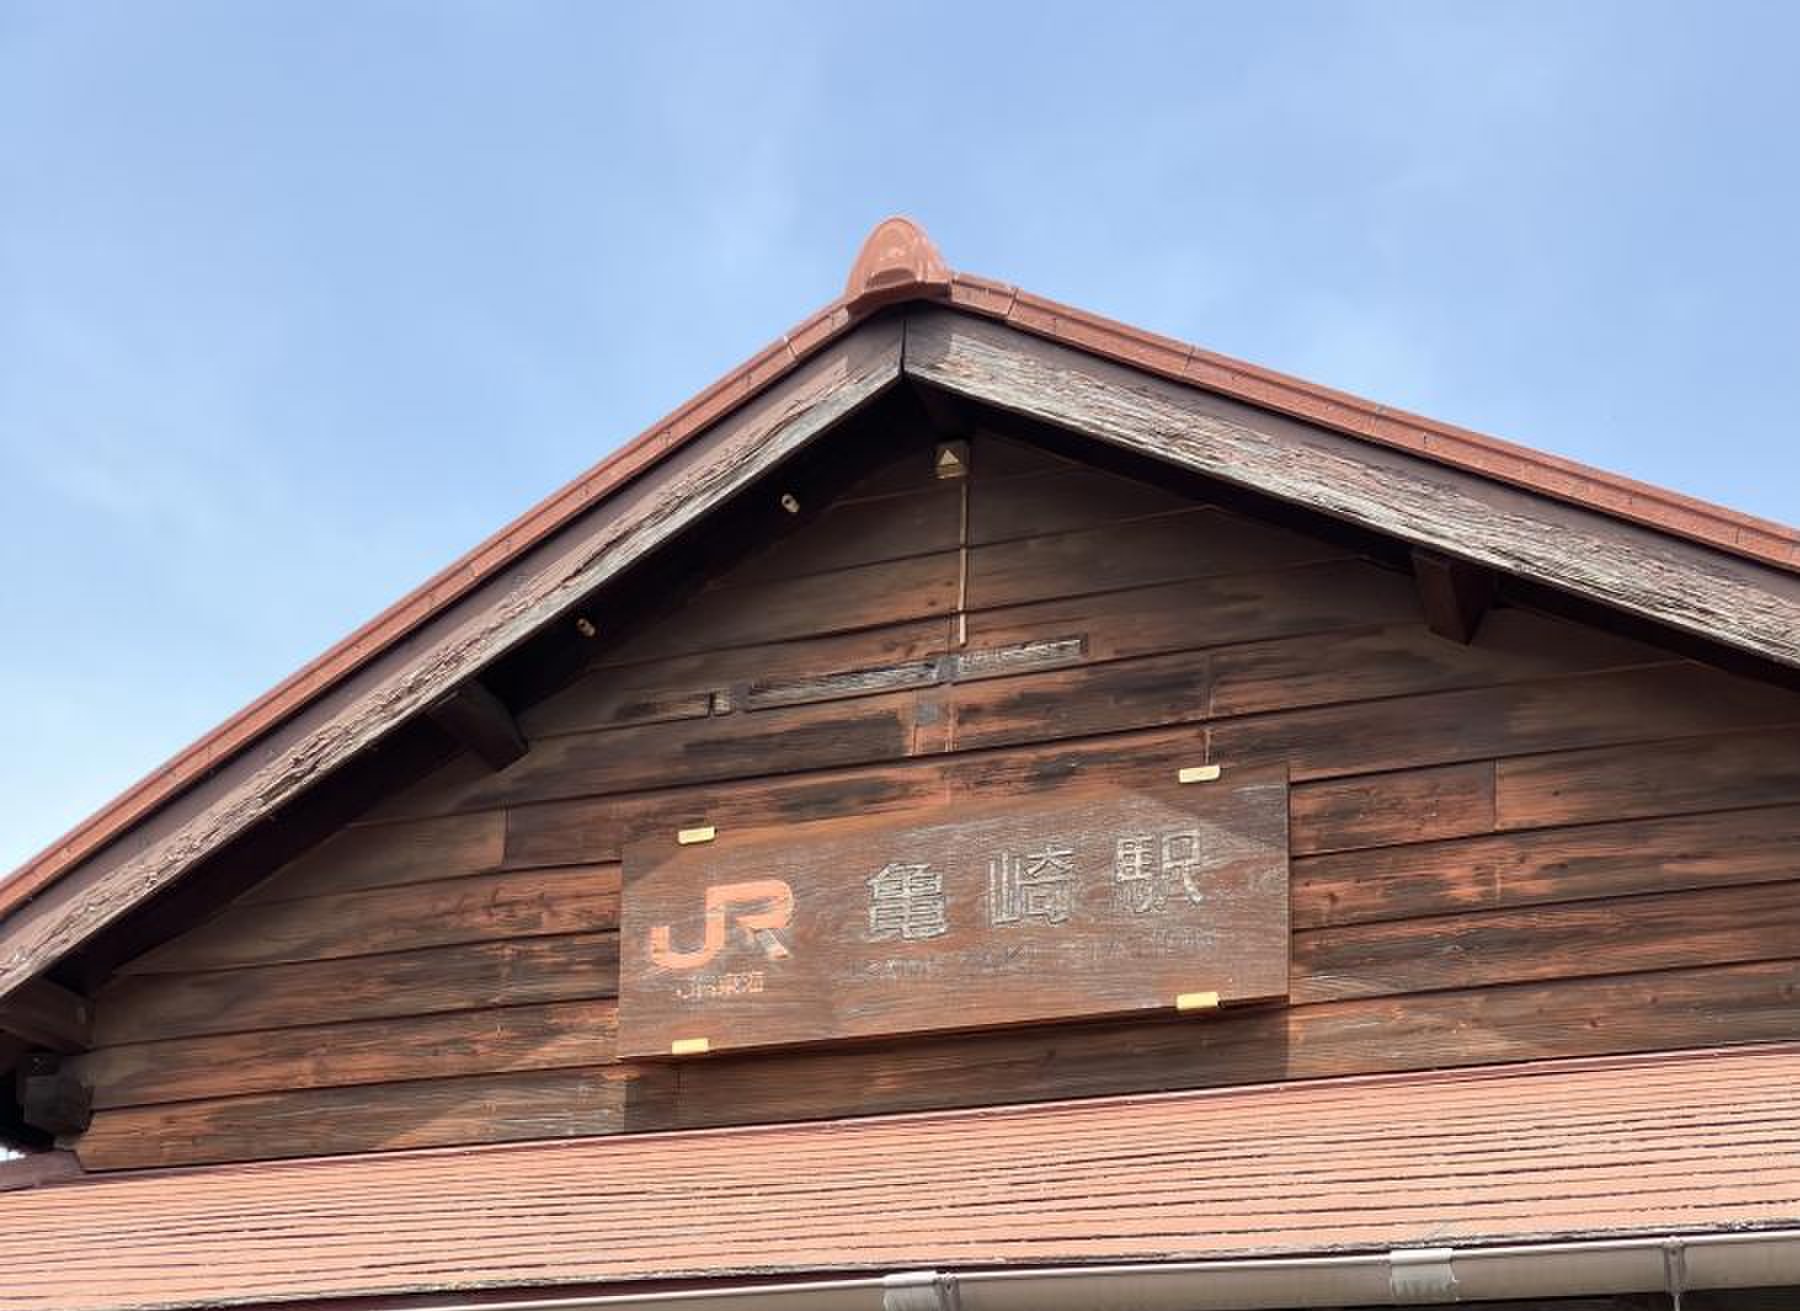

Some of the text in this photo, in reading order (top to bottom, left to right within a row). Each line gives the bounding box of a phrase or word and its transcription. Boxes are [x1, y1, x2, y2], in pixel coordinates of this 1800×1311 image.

[651, 879, 794, 969] JR
[864, 829, 1205, 943] 亀崎駅
